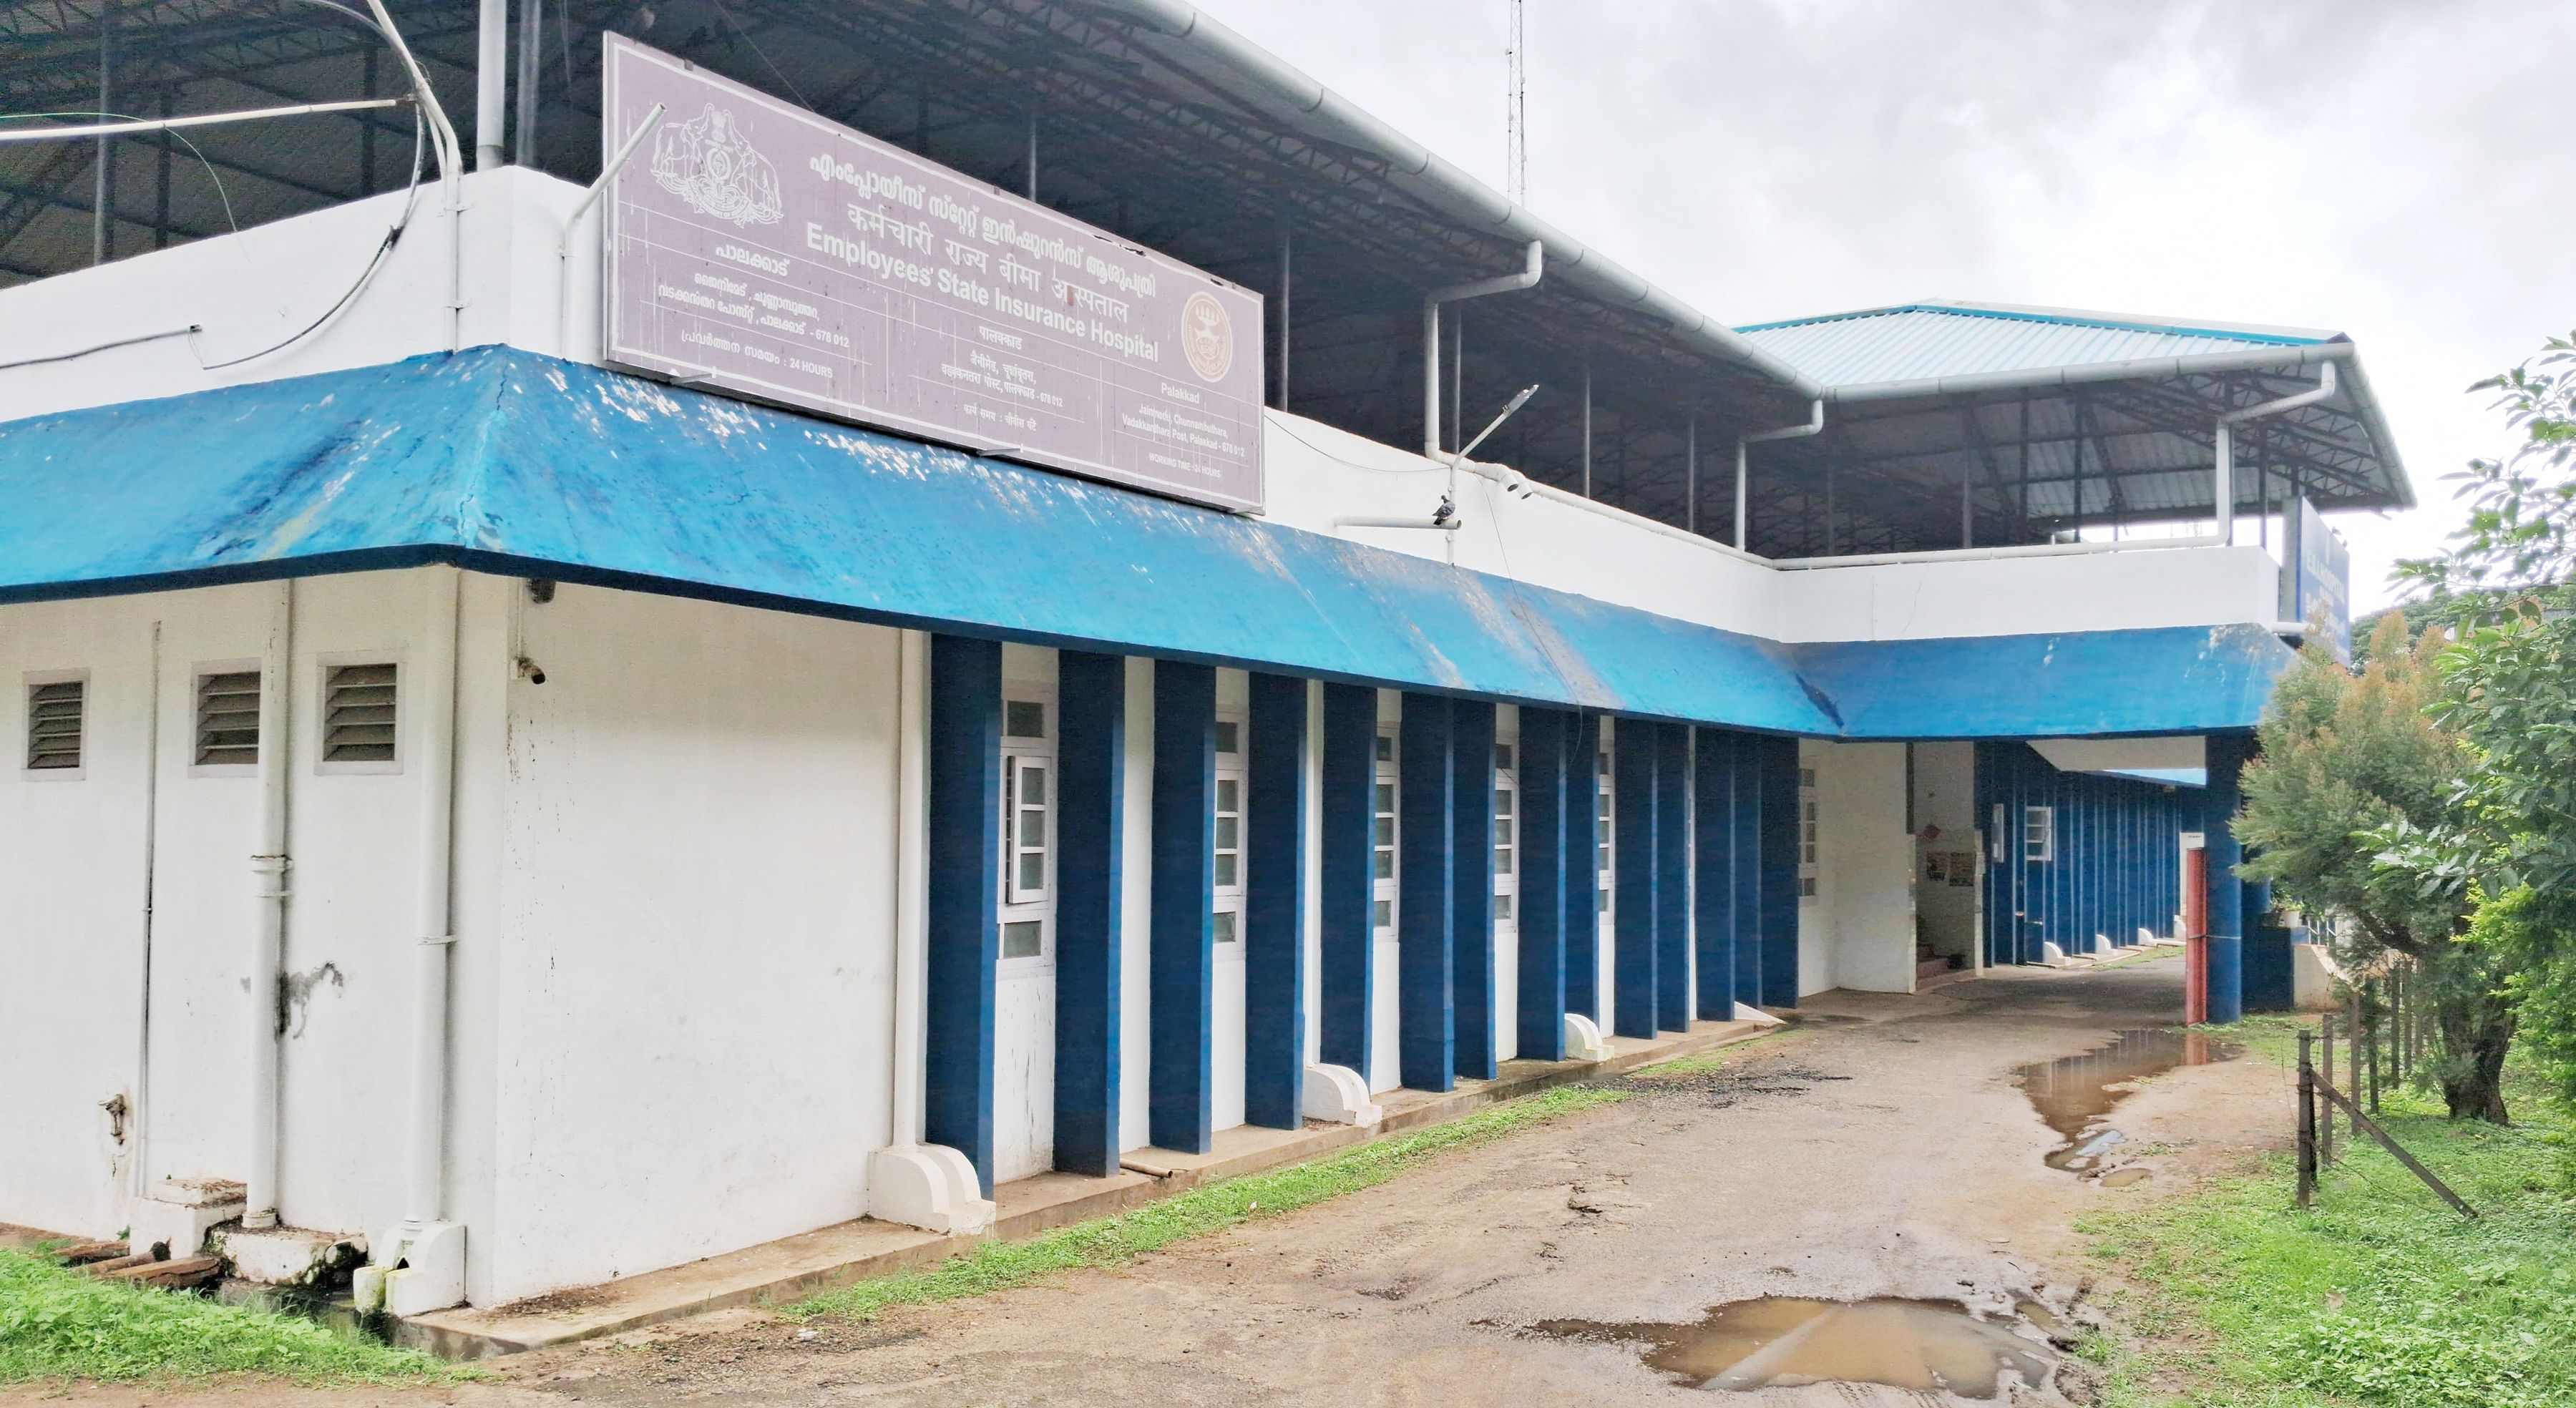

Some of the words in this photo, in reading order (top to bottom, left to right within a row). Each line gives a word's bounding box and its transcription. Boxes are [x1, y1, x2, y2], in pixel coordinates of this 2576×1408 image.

[716, 244, 790, 277] പാലക്കാട്
[847, 203, 934, 255] कर्मचारी
[945, 238, 989, 274] राज्य
[999, 253, 1041, 292] बीमा
[807, 222, 934, 287] Employees'
[938, 268, 989, 306] State
[995, 287, 1085, 337] Insurance
[1091, 319, 1158, 362] Hospital
[1086, 255, 1156, 298] ആശുപത്രി
[816, 329, 831, 344] 678
[834, 333, 849, 348] 012
[745, 346, 780, 365] സമയം
[789, 358, 801, 370] 24
[802, 361, 833, 378] HOURS
[1040, 392, 1051, 405] 678
[1161, 382, 1200, 404] Palakkad
[1122, 413, 1170, 437] Vadakkanthara
[1189, 434, 1217, 450] Palakkad
[1221, 442, 1233, 454] 678
[1148, 452, 1176, 467] WORKING
[1177, 459, 1191, 471] TIME
[1201, 466, 1221, 478] HOURS
